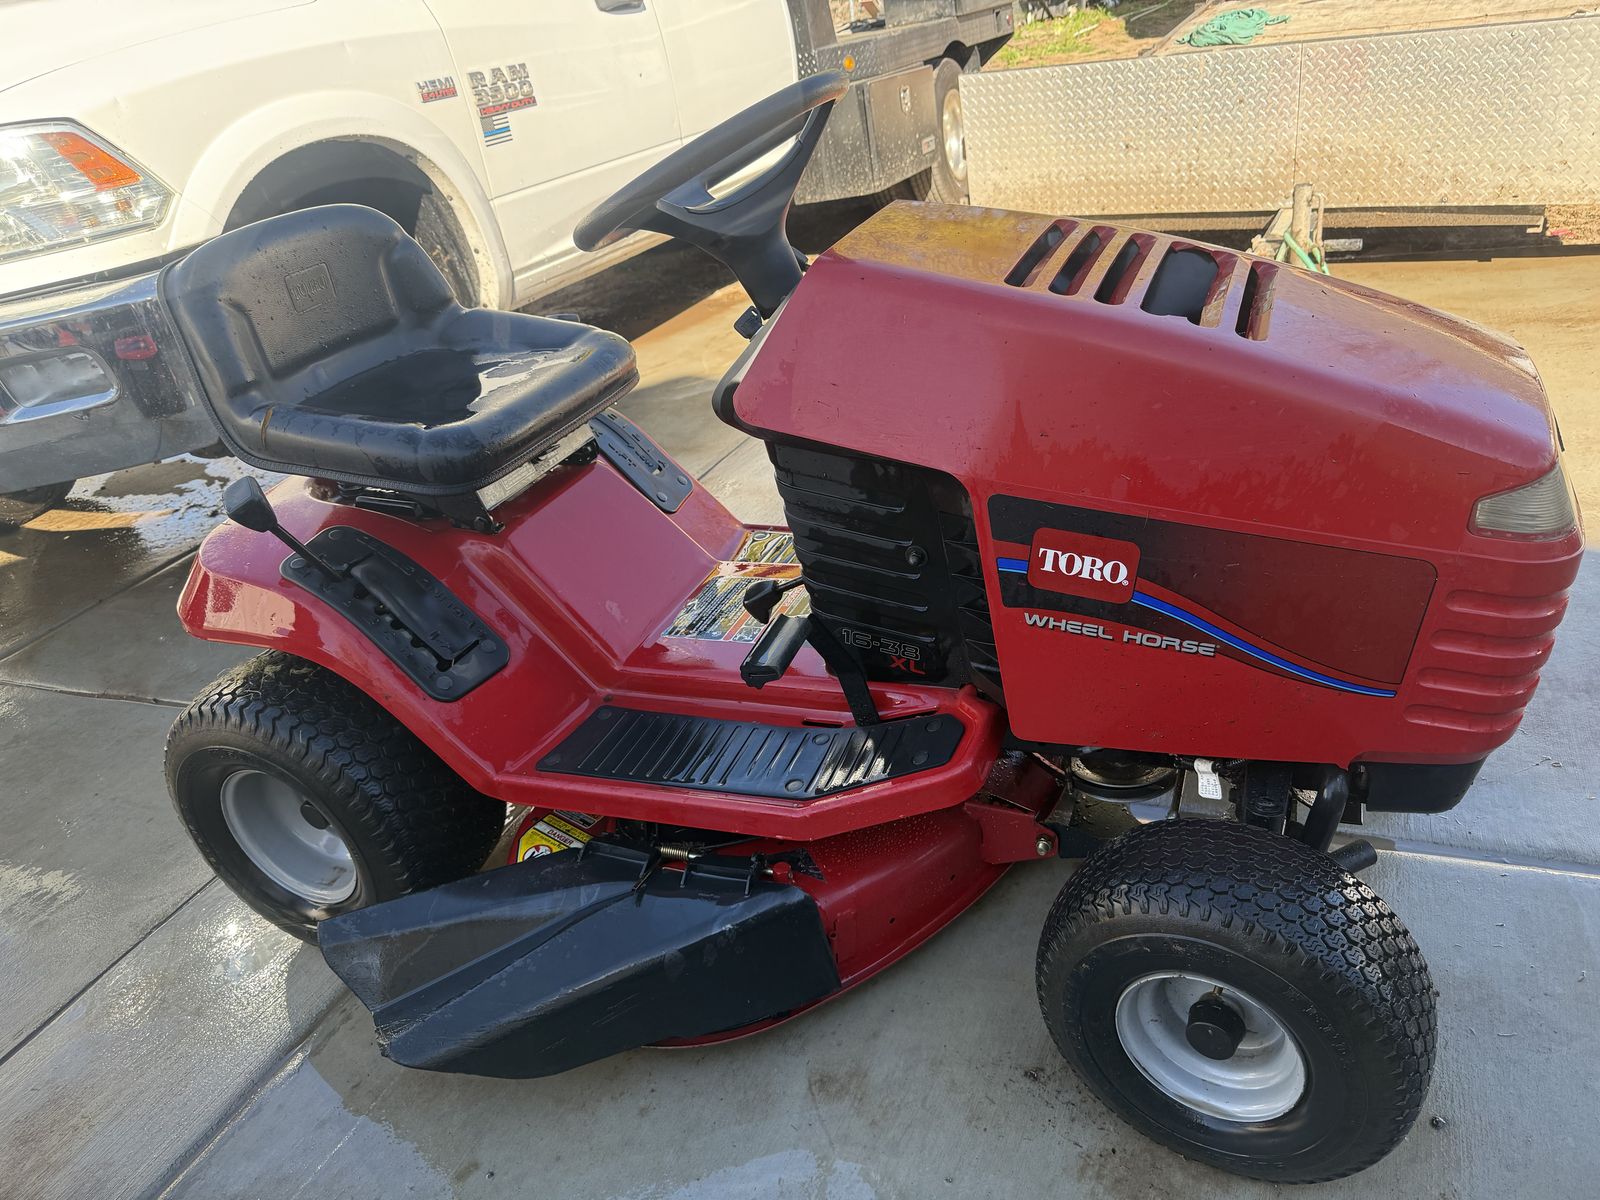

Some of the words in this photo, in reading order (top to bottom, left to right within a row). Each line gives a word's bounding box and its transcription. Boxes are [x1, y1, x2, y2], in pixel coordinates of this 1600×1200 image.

[416, 76, 456, 92] HEMI
[467, 63, 529, 89] RAM
[511, 97, 535, 110] DUTY
[1038, 548, 1128, 585] TORO
[842, 628, 920, 661] 16-38
[1024, 612, 1113, 640] WHEEL
[1123, 630, 1216, 657] HORSE
[889, 655, 926, 675] XL
[547, 829, 575, 846] DANGER
